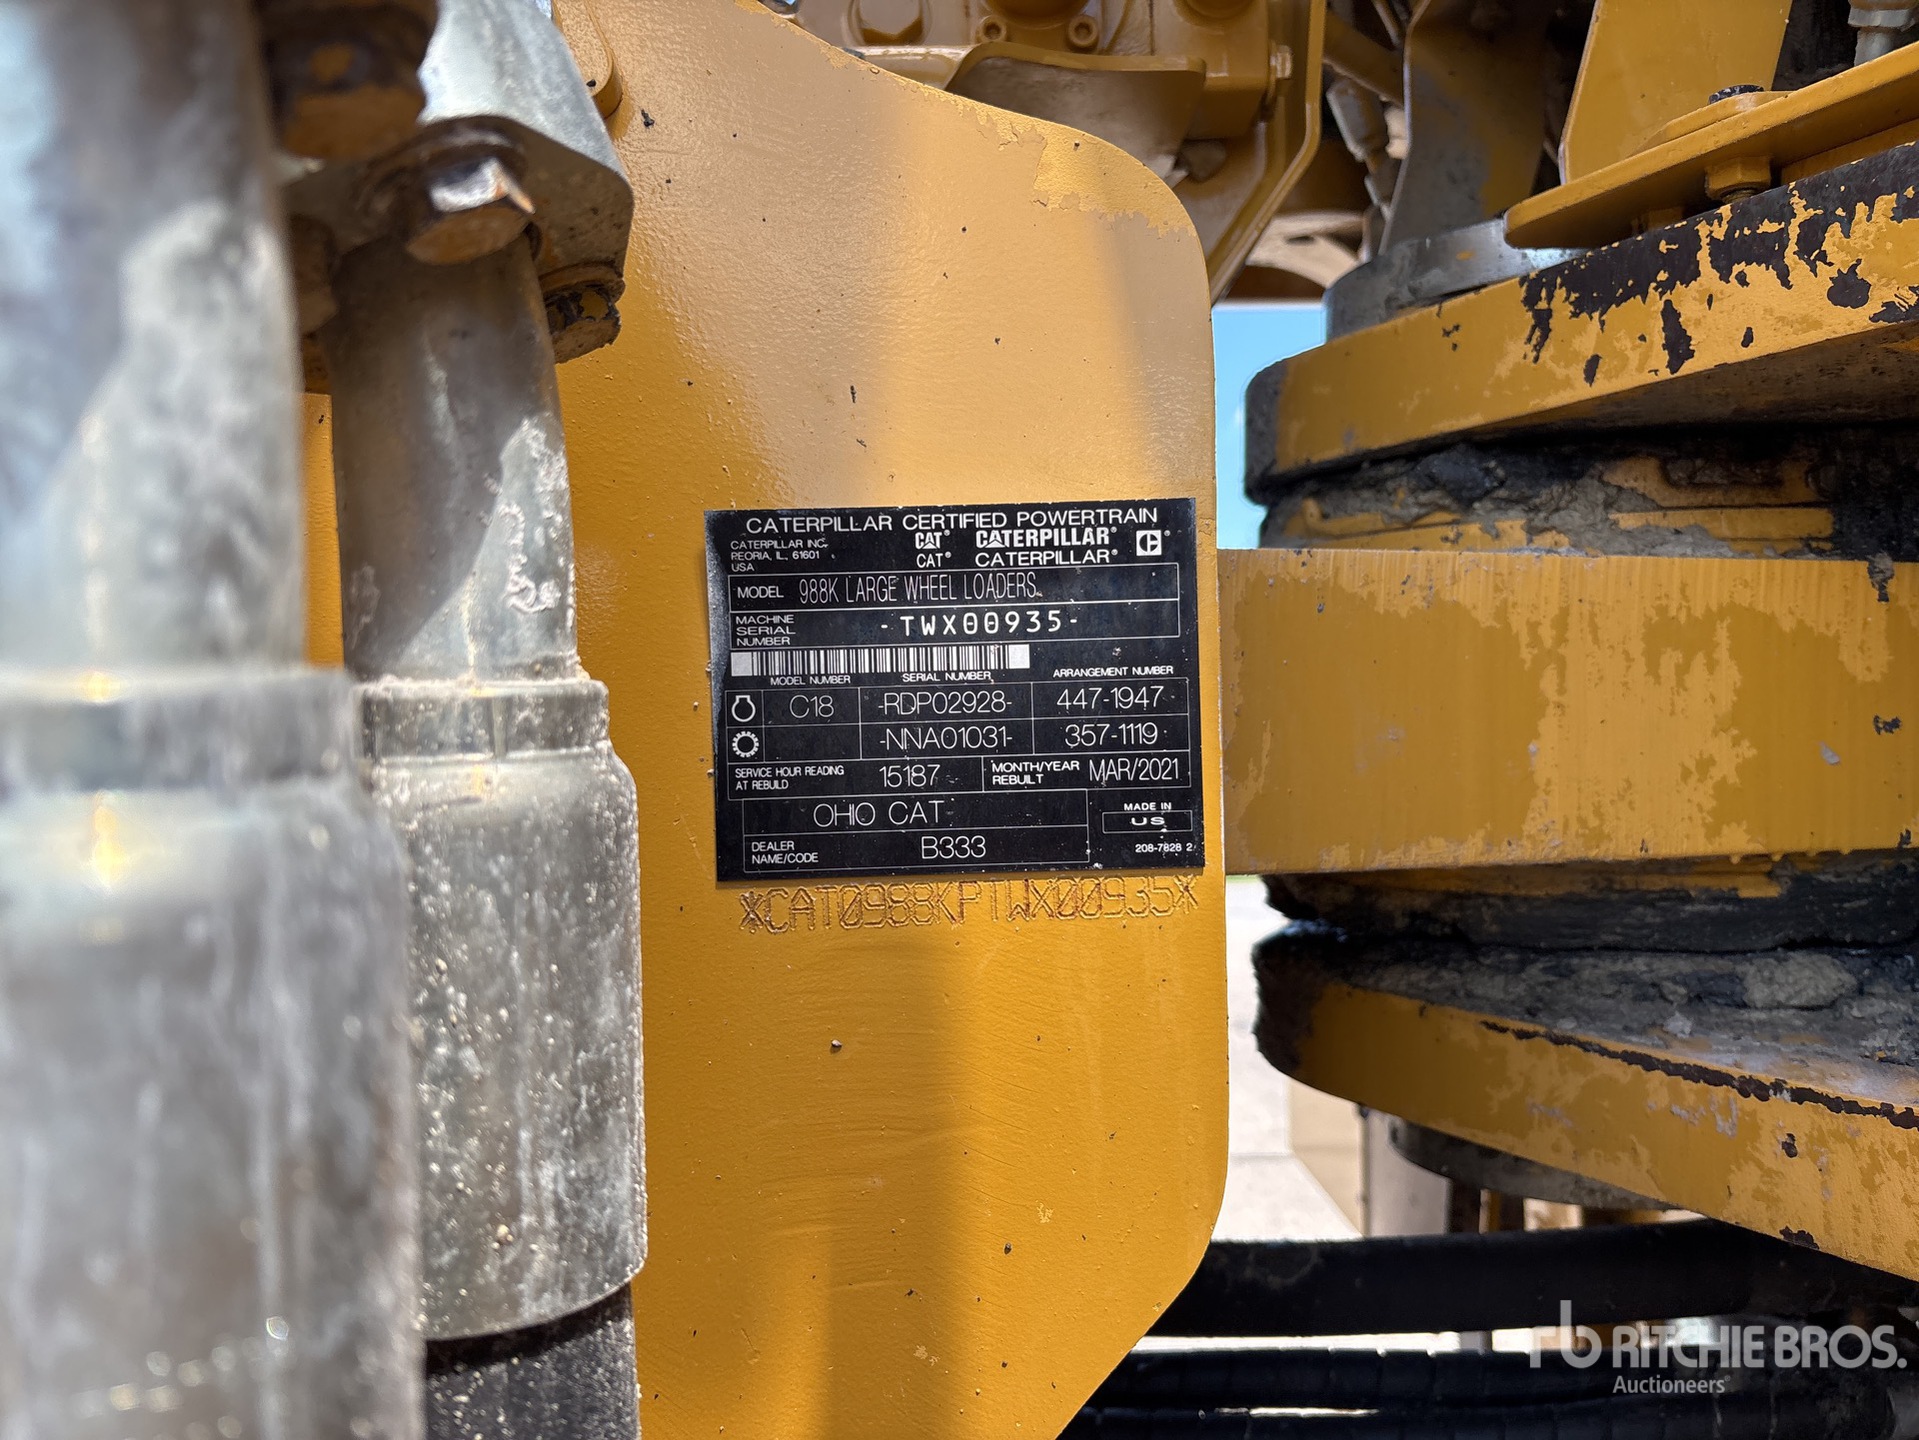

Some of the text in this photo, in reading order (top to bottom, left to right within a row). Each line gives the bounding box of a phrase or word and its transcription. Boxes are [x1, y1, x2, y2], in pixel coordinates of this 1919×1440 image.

[746, 507, 1158, 534] CATERPILLAR CERTIFIED POWERTRAIN
[730, 538, 803, 550] CATERPILLAR
[791, 550, 820, 560] 61601
[731, 562, 755, 573] USA
[737, 571, 1038, 604] MODEL 988K LARGE WHEEL LOADERS
[735, 614, 795, 625] MACHINE
[736, 626, 796, 637] SERIAL
[736, 637, 791, 647] NUMBER
[902, 671, 992, 683] SERIAL NUMBER
[1053, 665, 1174, 678] ARRANGEMENT NUMBER
[770, 675, 851, 687] MODEL NUMBER
[789, 694, 835, 719] C18
[1056, 685, 1164, 710] 447-1947
[1064, 722, 1158, 747] 357-1119
[735, 765, 845, 778] SERVICE HOUR READING
[991, 757, 1179, 781] MONTH/YEAR MAR/2021
[879, 764, 941, 787] 15187
[992, 773, 1044, 784] REBUILT
[735, 779, 789, 791] AT REBUILD
[1124, 802, 1172, 811] MADE IN
[813, 800, 945, 828] OHIO CAT
[751, 840, 795, 851] DEALER
[921, 835, 986, 860] B333
[1135, 843, 1182, 853] 208-7828
[751, 852, 819, 864] NAME/CODE
